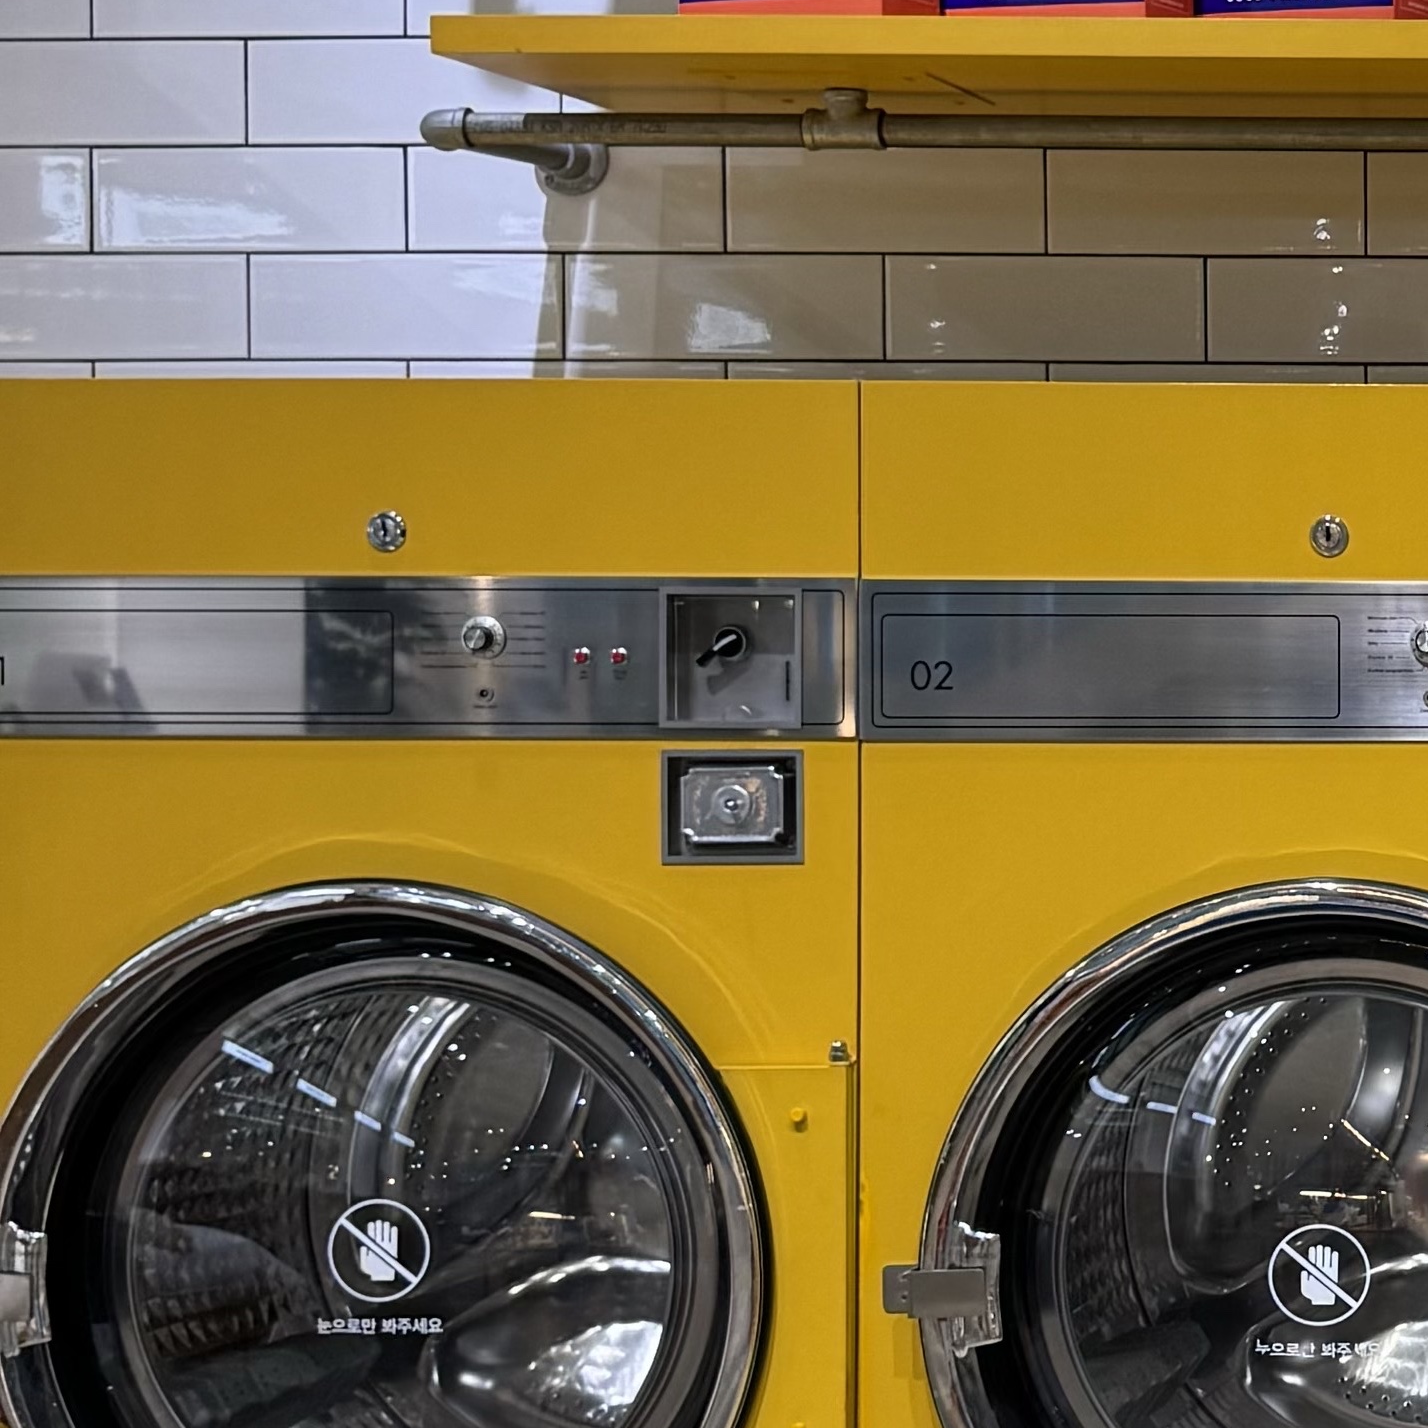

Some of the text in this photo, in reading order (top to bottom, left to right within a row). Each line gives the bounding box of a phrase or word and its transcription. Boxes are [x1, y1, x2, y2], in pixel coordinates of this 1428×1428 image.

[910, 660, 954, 691] 02
[316, 1317, 444, 1335] 눈으로만 봐주세요
